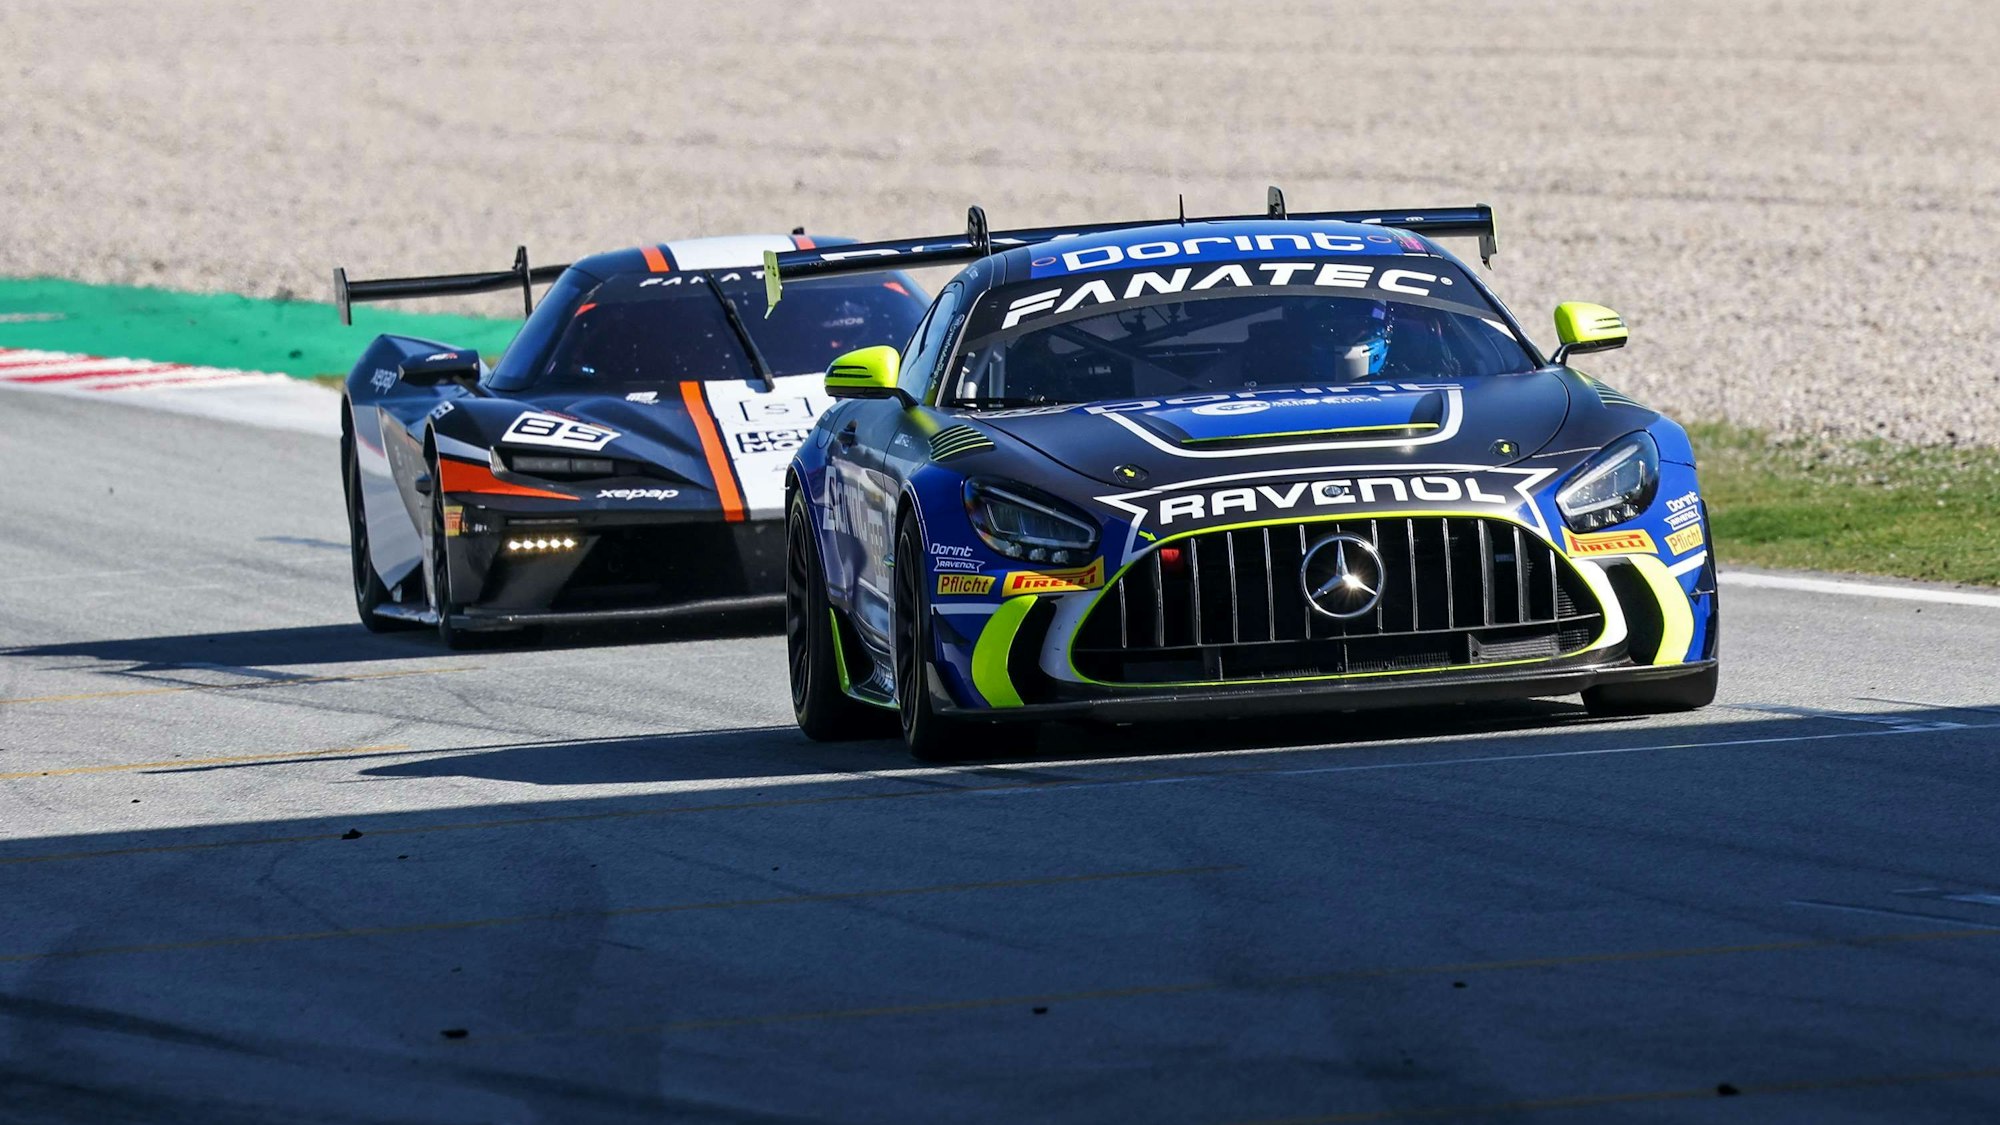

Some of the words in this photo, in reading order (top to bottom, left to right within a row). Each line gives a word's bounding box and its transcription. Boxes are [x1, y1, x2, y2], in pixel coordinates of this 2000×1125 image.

[1061, 232, 1364, 272] Dorint
[512, 417, 611, 443] 85
[596, 489, 680, 501] xepap
[1159, 476, 1506, 525] RAVENOL
[1666, 490, 1699, 512] Dorint
[930, 542, 974, 558] Dorint
[1570, 534, 1646, 553] PIRELLI
[1669, 528, 1701, 552] Pflicht
[938, 561, 977, 570] RAVENOL
[941, 576, 990, 593] Pflicht
[1012, 566, 1097, 590] PIRELLI
